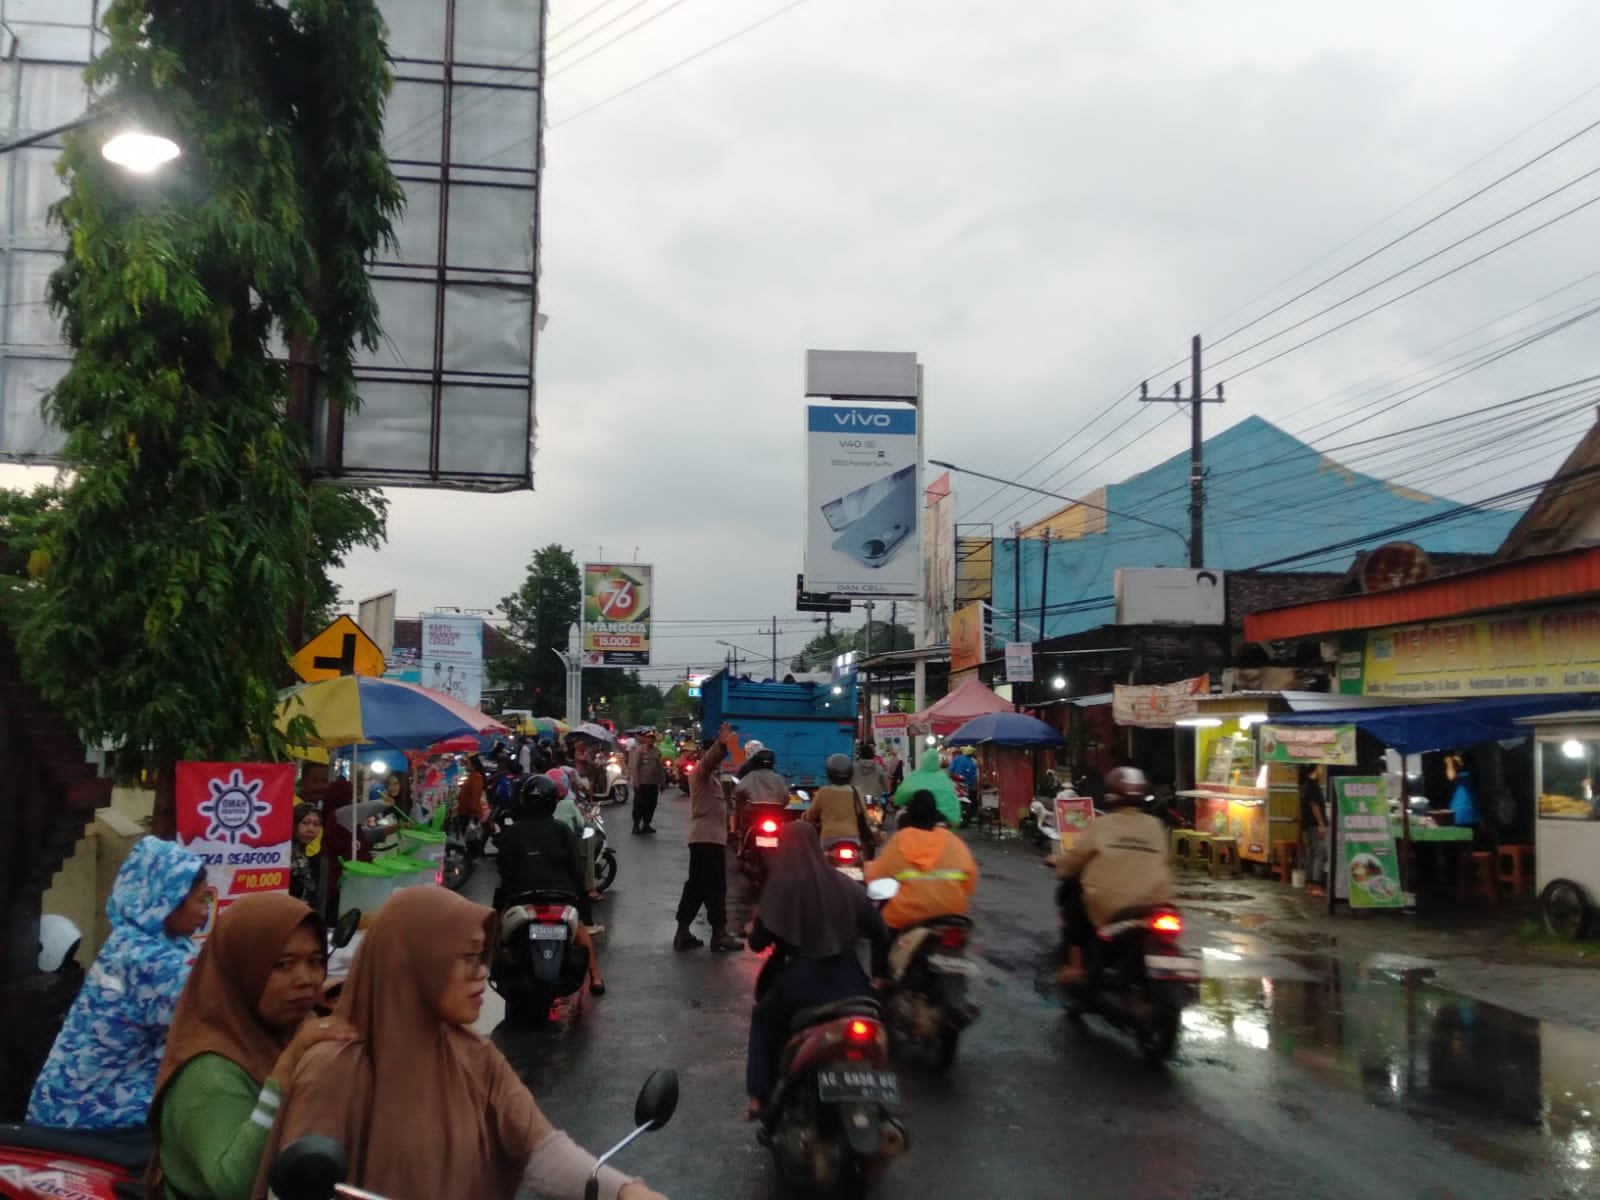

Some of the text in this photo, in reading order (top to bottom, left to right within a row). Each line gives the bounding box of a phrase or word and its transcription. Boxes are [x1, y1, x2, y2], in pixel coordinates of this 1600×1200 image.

[833, 409, 891, 426] vivo
[594, 581, 633, 615] 76
[587, 621, 647, 633] MANGGA
[227, 851, 281, 865] SEAFOOD
